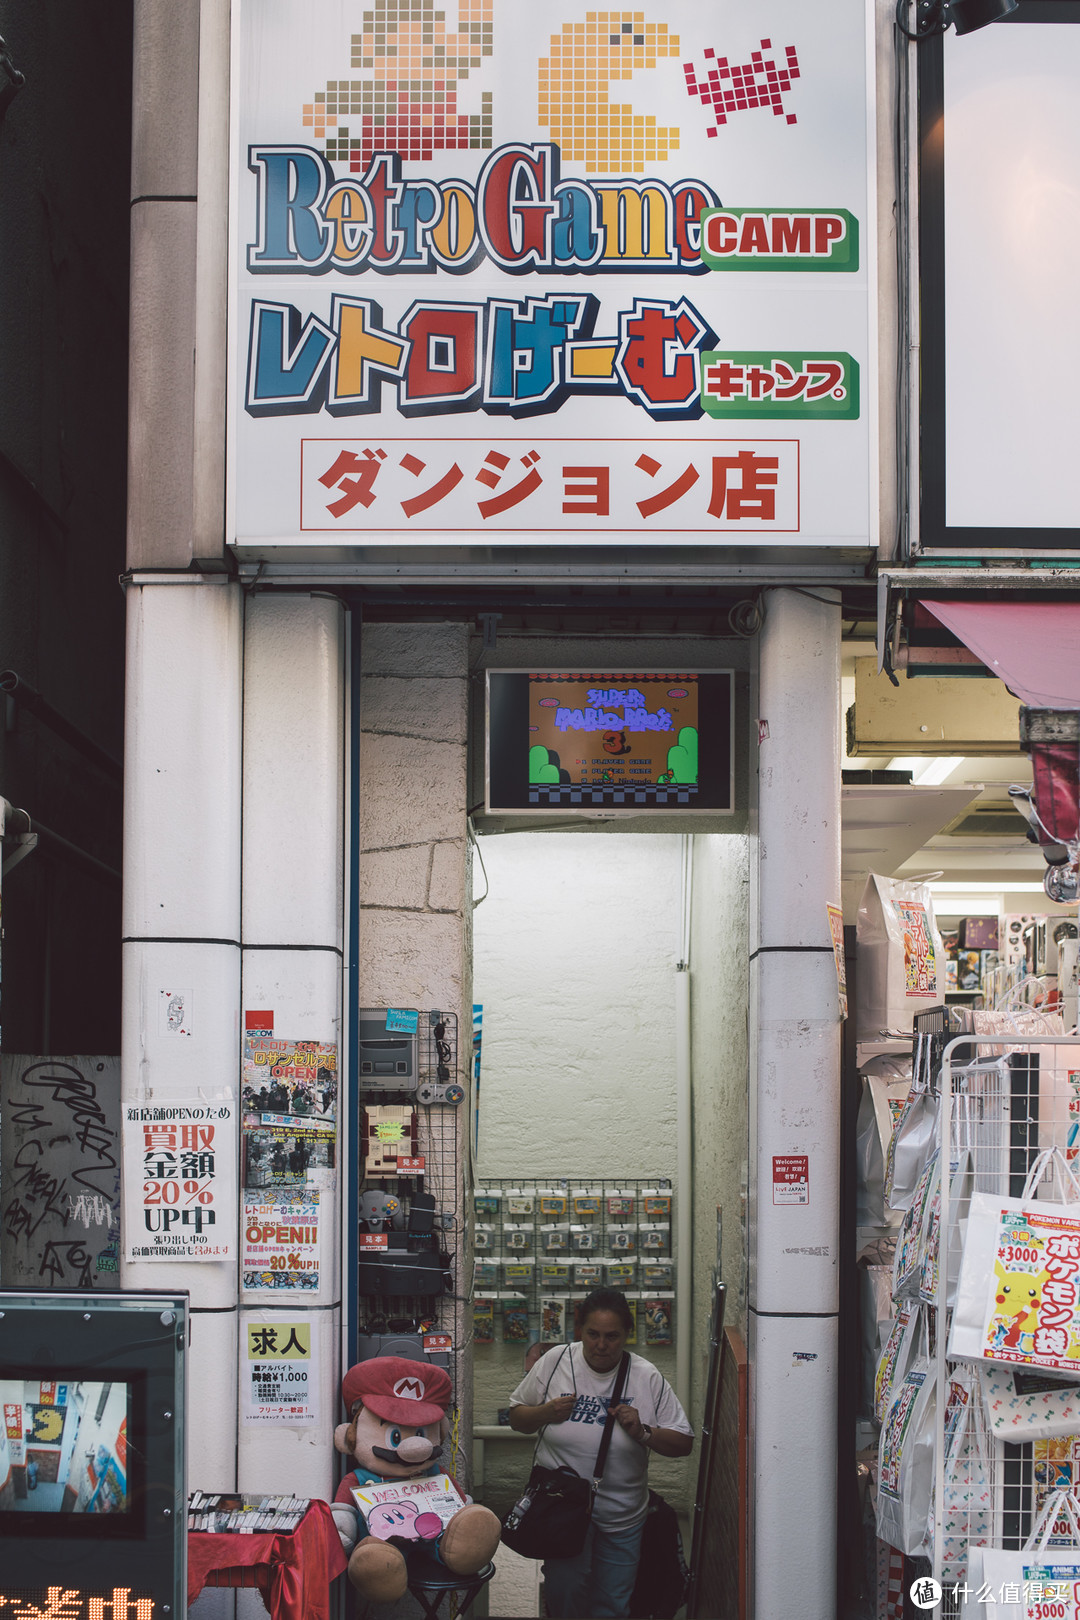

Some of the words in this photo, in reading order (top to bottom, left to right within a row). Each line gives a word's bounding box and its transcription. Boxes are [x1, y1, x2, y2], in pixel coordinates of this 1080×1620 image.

[705, 213, 847, 257] CAMP
[245, 293, 719, 421] レトロげーむ
[705, 361, 848, 402] キャンプ
[318, 447, 780, 521] ダンジョン店
[586, 688, 646, 708] SUPER
[554, 707, 624, 731] MARIO
[602, 731, 623, 753] 3
[254, 1051, 336, 1071] ロサンゼルス店
[271, 1066, 317, 1079] OPEN
[127, 1107, 231, 1121] 新店舗OPENのため
[143, 1124, 216, 1152] 買取
[144, 1151, 216, 1179] 金額
[402, 1158, 419, 1166] 見本
[143, 1180, 214, 1205] 20%
[144, 1206, 216, 1234] UP中
[1029, 1215, 1061, 1225] POKEMON
[246, 1226, 317, 1244] OPEN!!
[365, 1235, 382, 1243] 見本
[131, 1245, 230, 1256] 高価買取商品も含みます
[251, 1328, 307, 1355] 求人
[429, 1337, 446, 1345] 見本
[1031, 1357, 1056, 1366] POCKET
[252, 1372, 308, 1382] 時給¥1,000
[573, 1402, 601, 1413] EED
[577, 1394, 598, 1404] ALL
[372, 1481, 441, 1503] WELCOME
